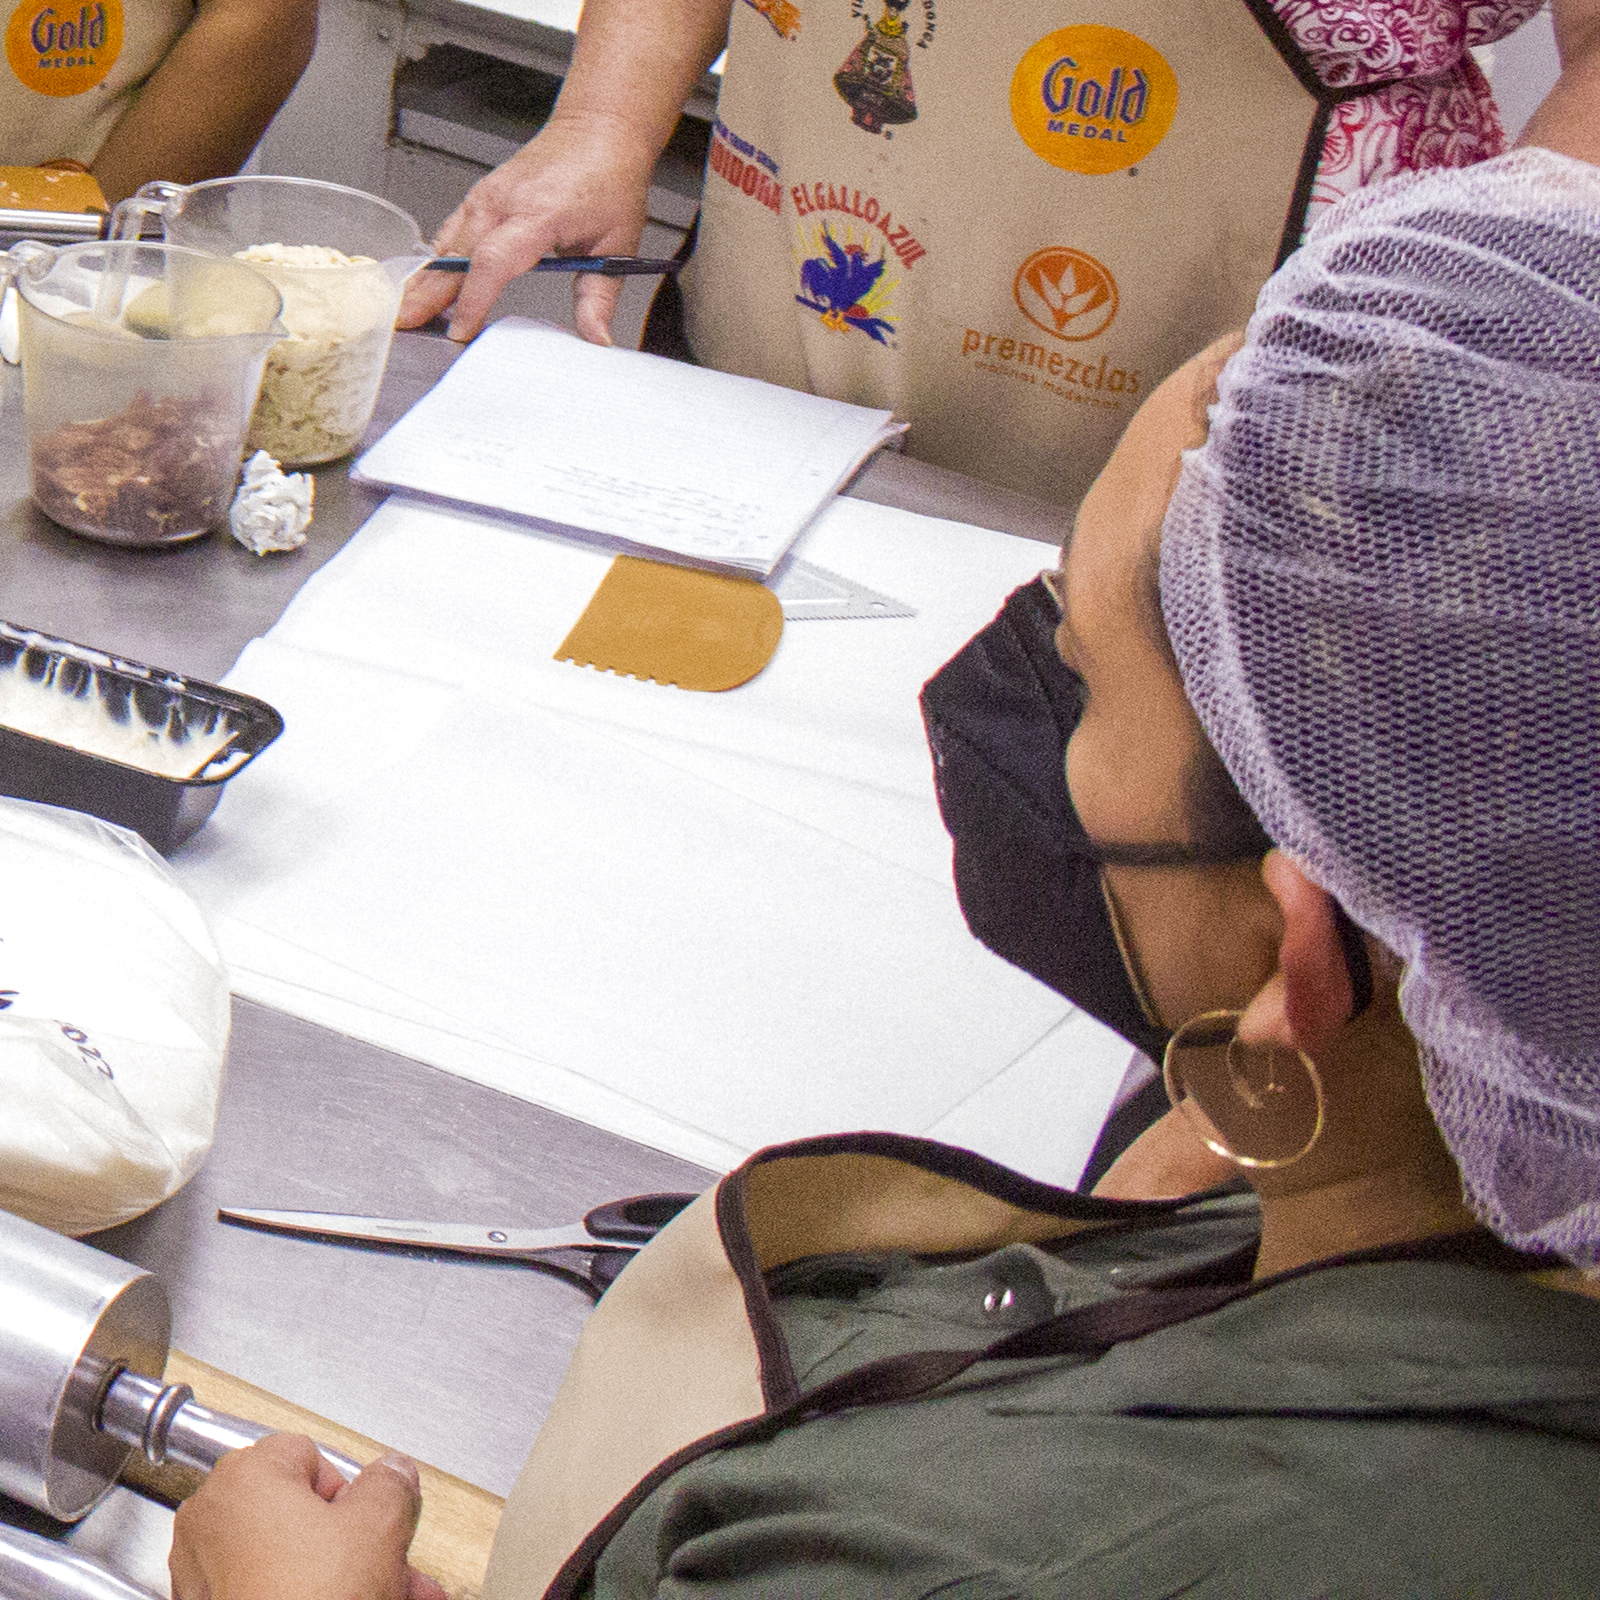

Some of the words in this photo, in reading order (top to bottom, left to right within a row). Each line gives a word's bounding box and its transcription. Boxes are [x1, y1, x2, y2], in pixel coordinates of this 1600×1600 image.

[30, 1, 106, 54] Gold
[1041, 55, 1148, 125] Gold
[1046, 119, 1128, 143] MEDAL
[961, 328, 1141, 395] premezclas
